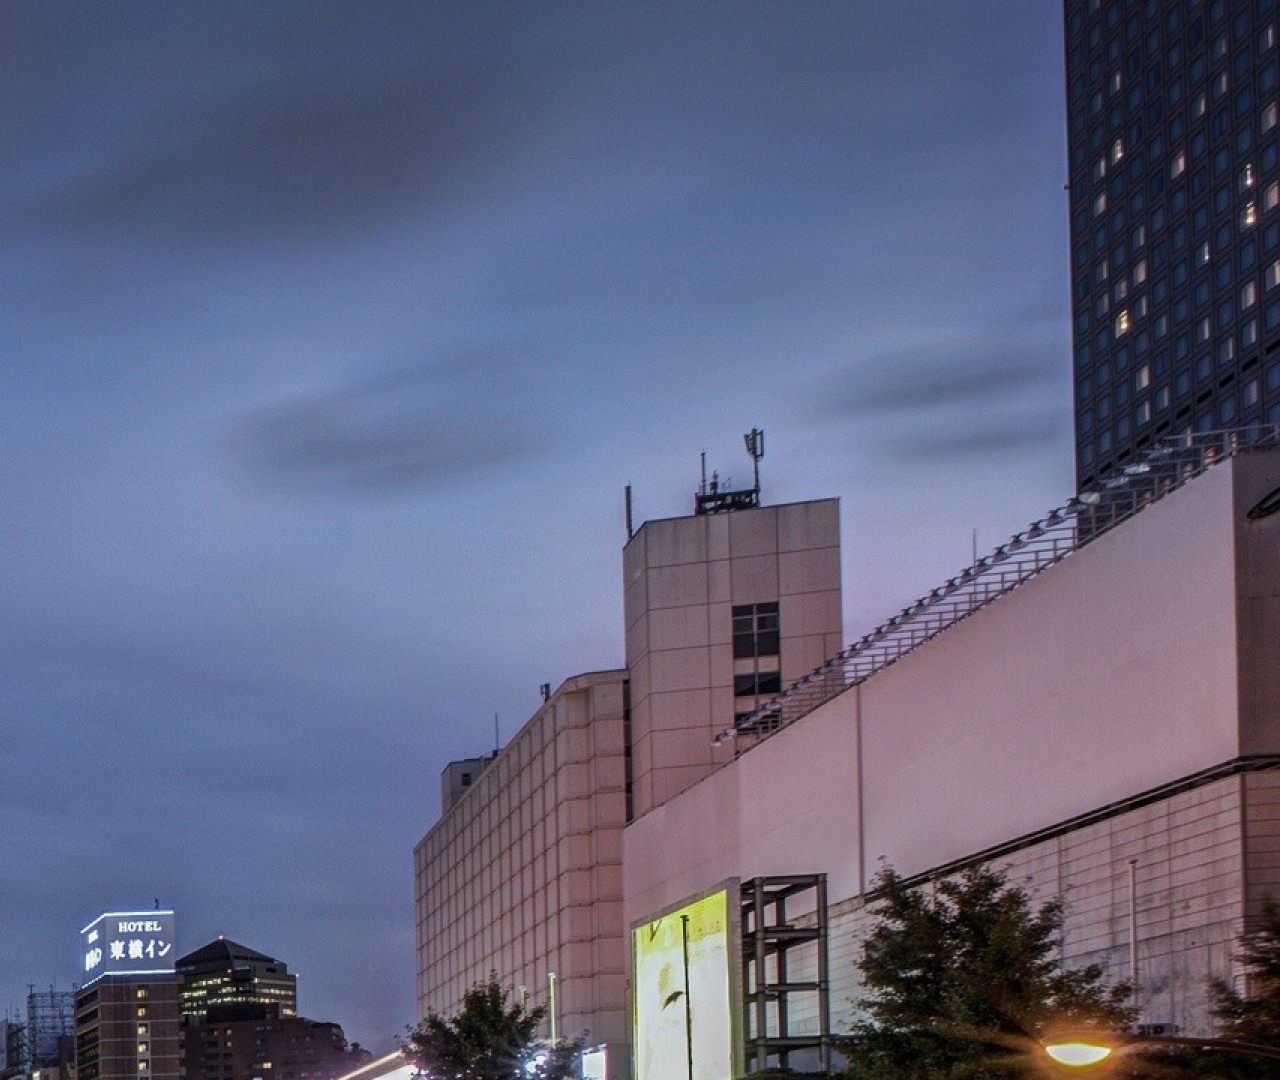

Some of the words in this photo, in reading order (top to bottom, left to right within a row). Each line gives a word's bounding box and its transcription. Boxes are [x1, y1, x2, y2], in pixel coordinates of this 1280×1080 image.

[118, 921, 162, 933] HOTEL
[109, 939, 171, 960] 東横イン
